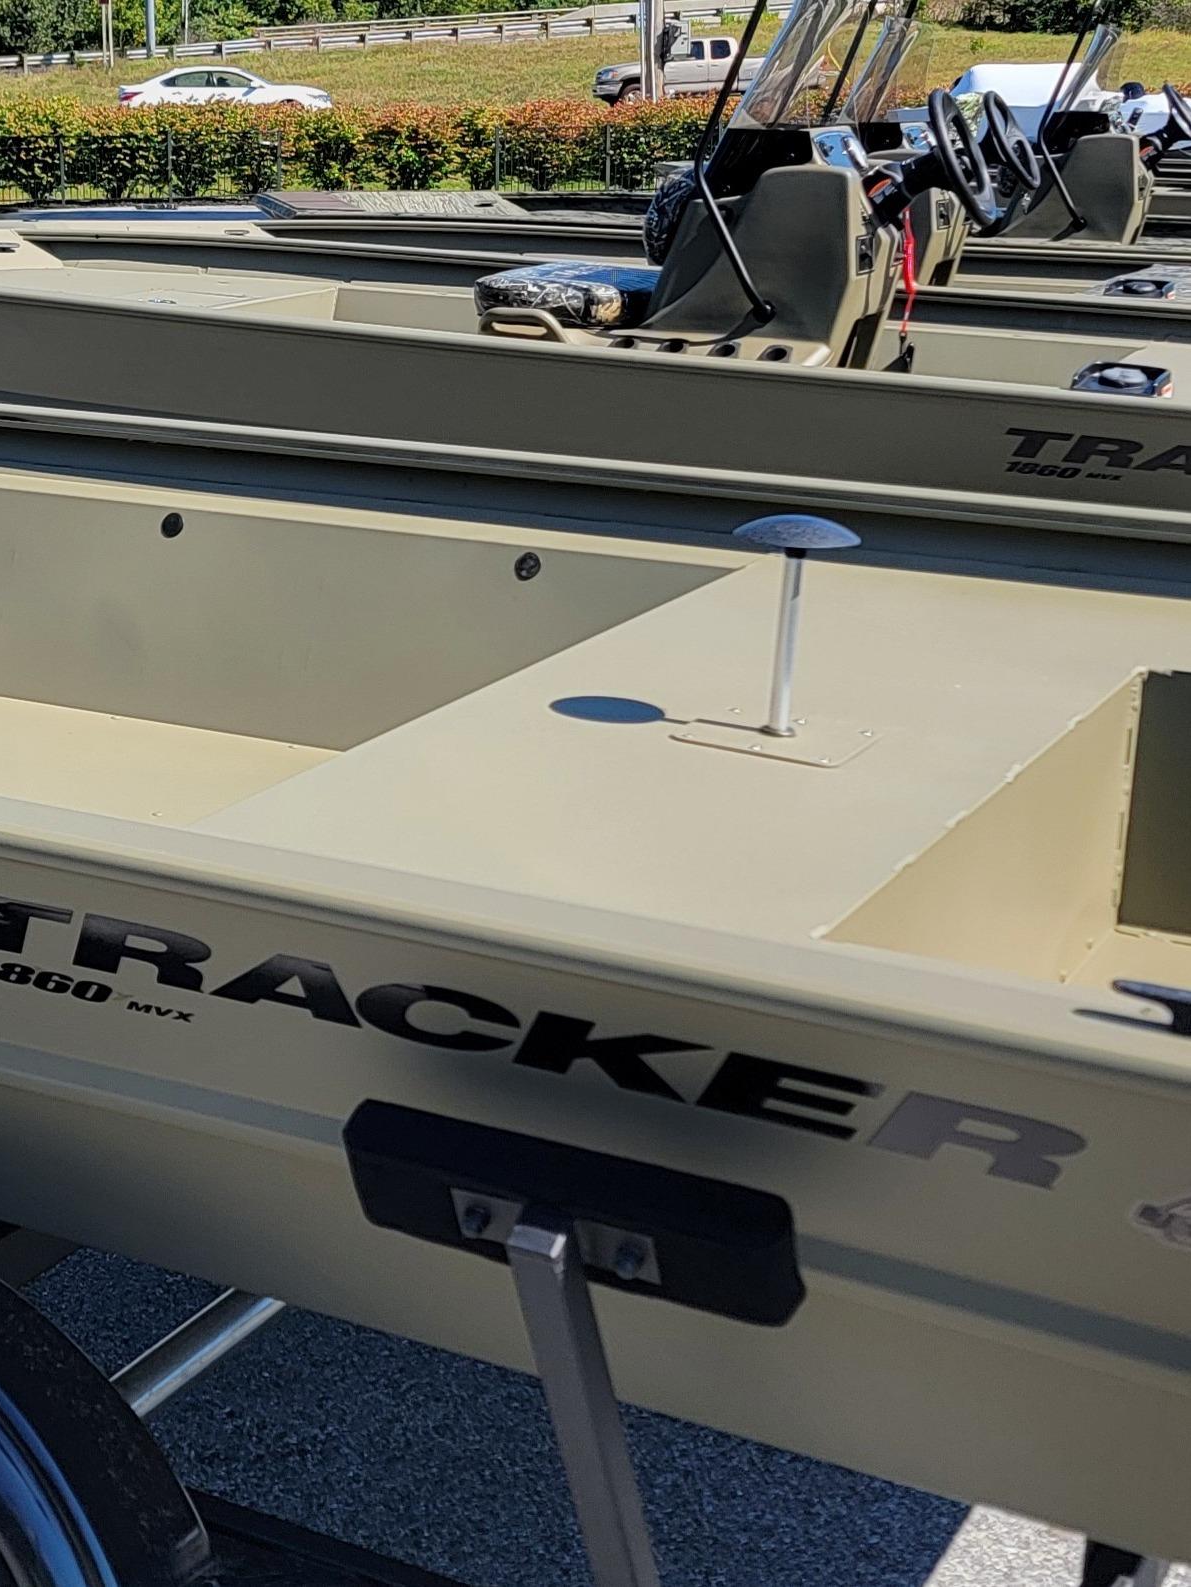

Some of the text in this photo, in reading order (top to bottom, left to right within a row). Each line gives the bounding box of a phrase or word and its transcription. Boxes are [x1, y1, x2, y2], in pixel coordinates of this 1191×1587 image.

[1004, 427, 1191, 475] TRA
[1004, 461, 1082, 479] 1860
[126, 1000, 196, 1024] MVX
